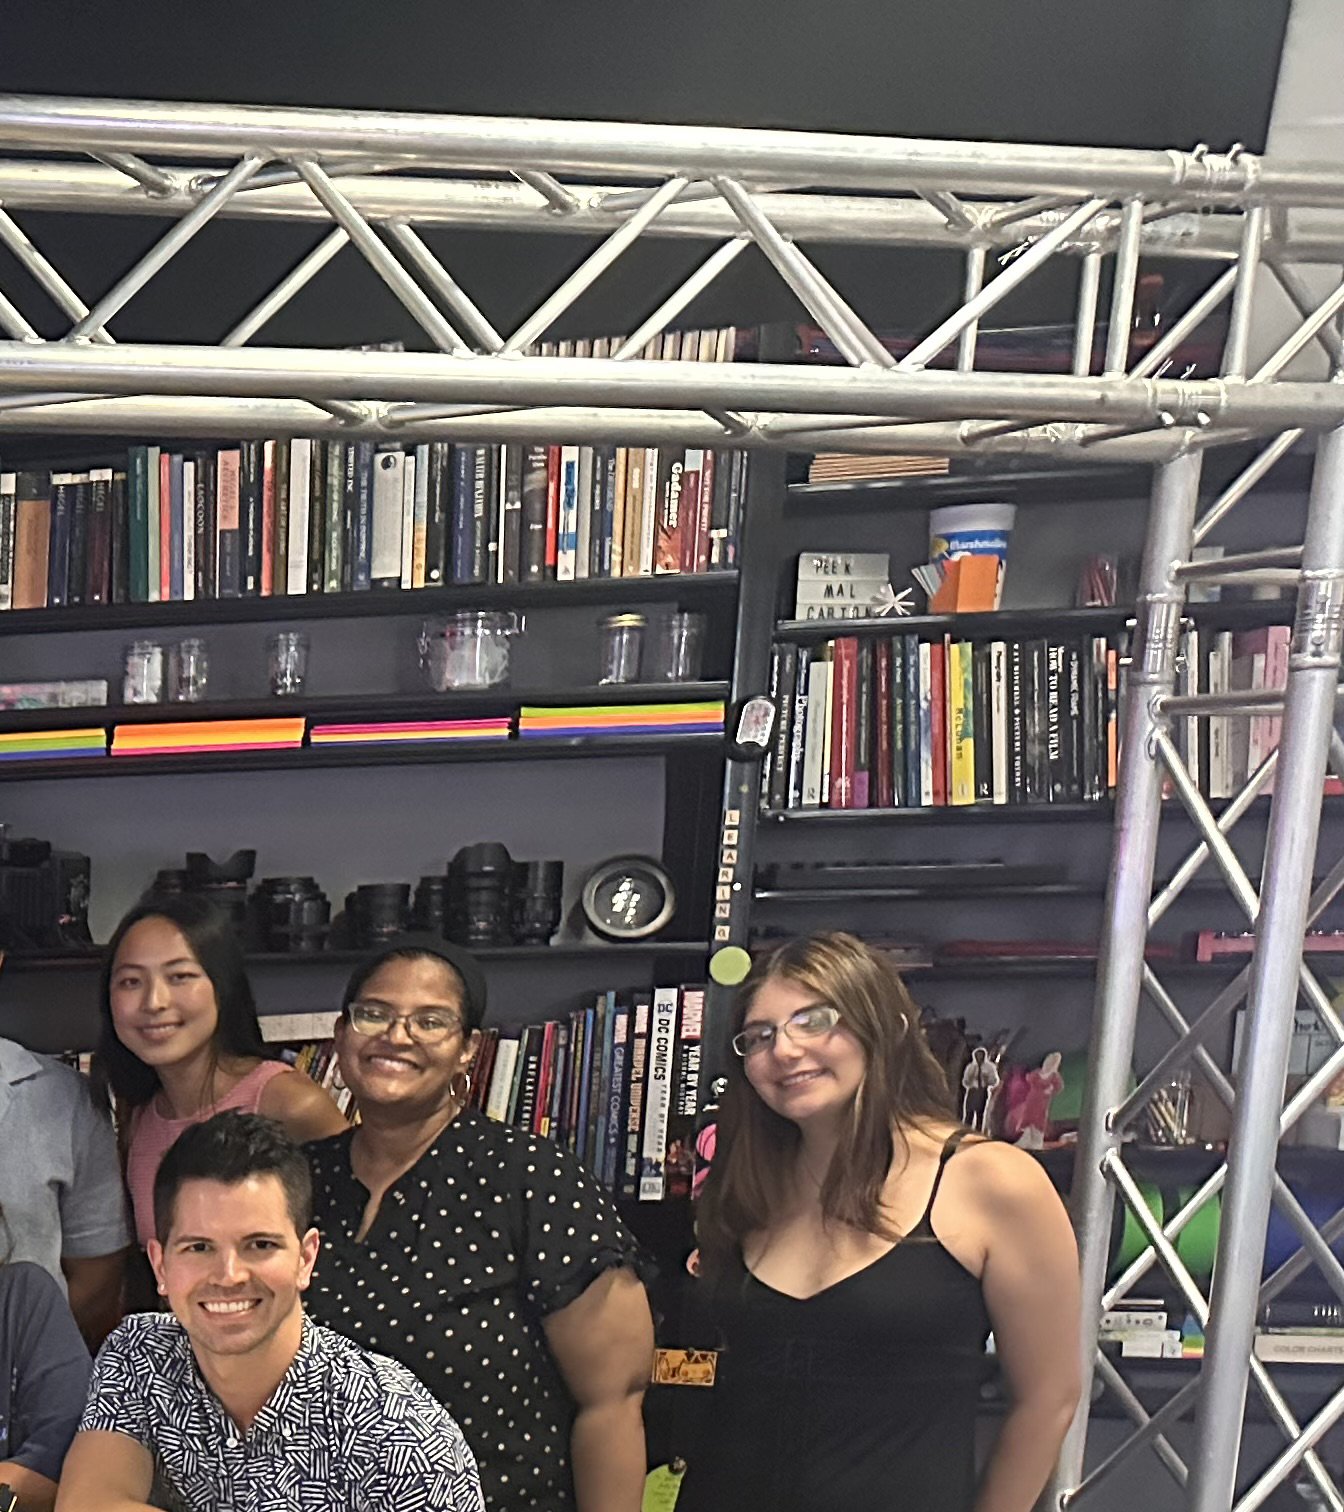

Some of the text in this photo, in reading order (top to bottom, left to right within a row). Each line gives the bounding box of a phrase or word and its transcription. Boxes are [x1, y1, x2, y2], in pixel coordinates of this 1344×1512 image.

[669, 462, 683, 528] Gadamer
[657, 1019, 670, 1034] DC
[681, 991, 704, 1039] MARVEL
[611, 1047, 625, 1093] GREATEST
[654, 1037, 668, 1081] COMICS
[684, 1045, 701, 1115] YEAR BY YEAR
